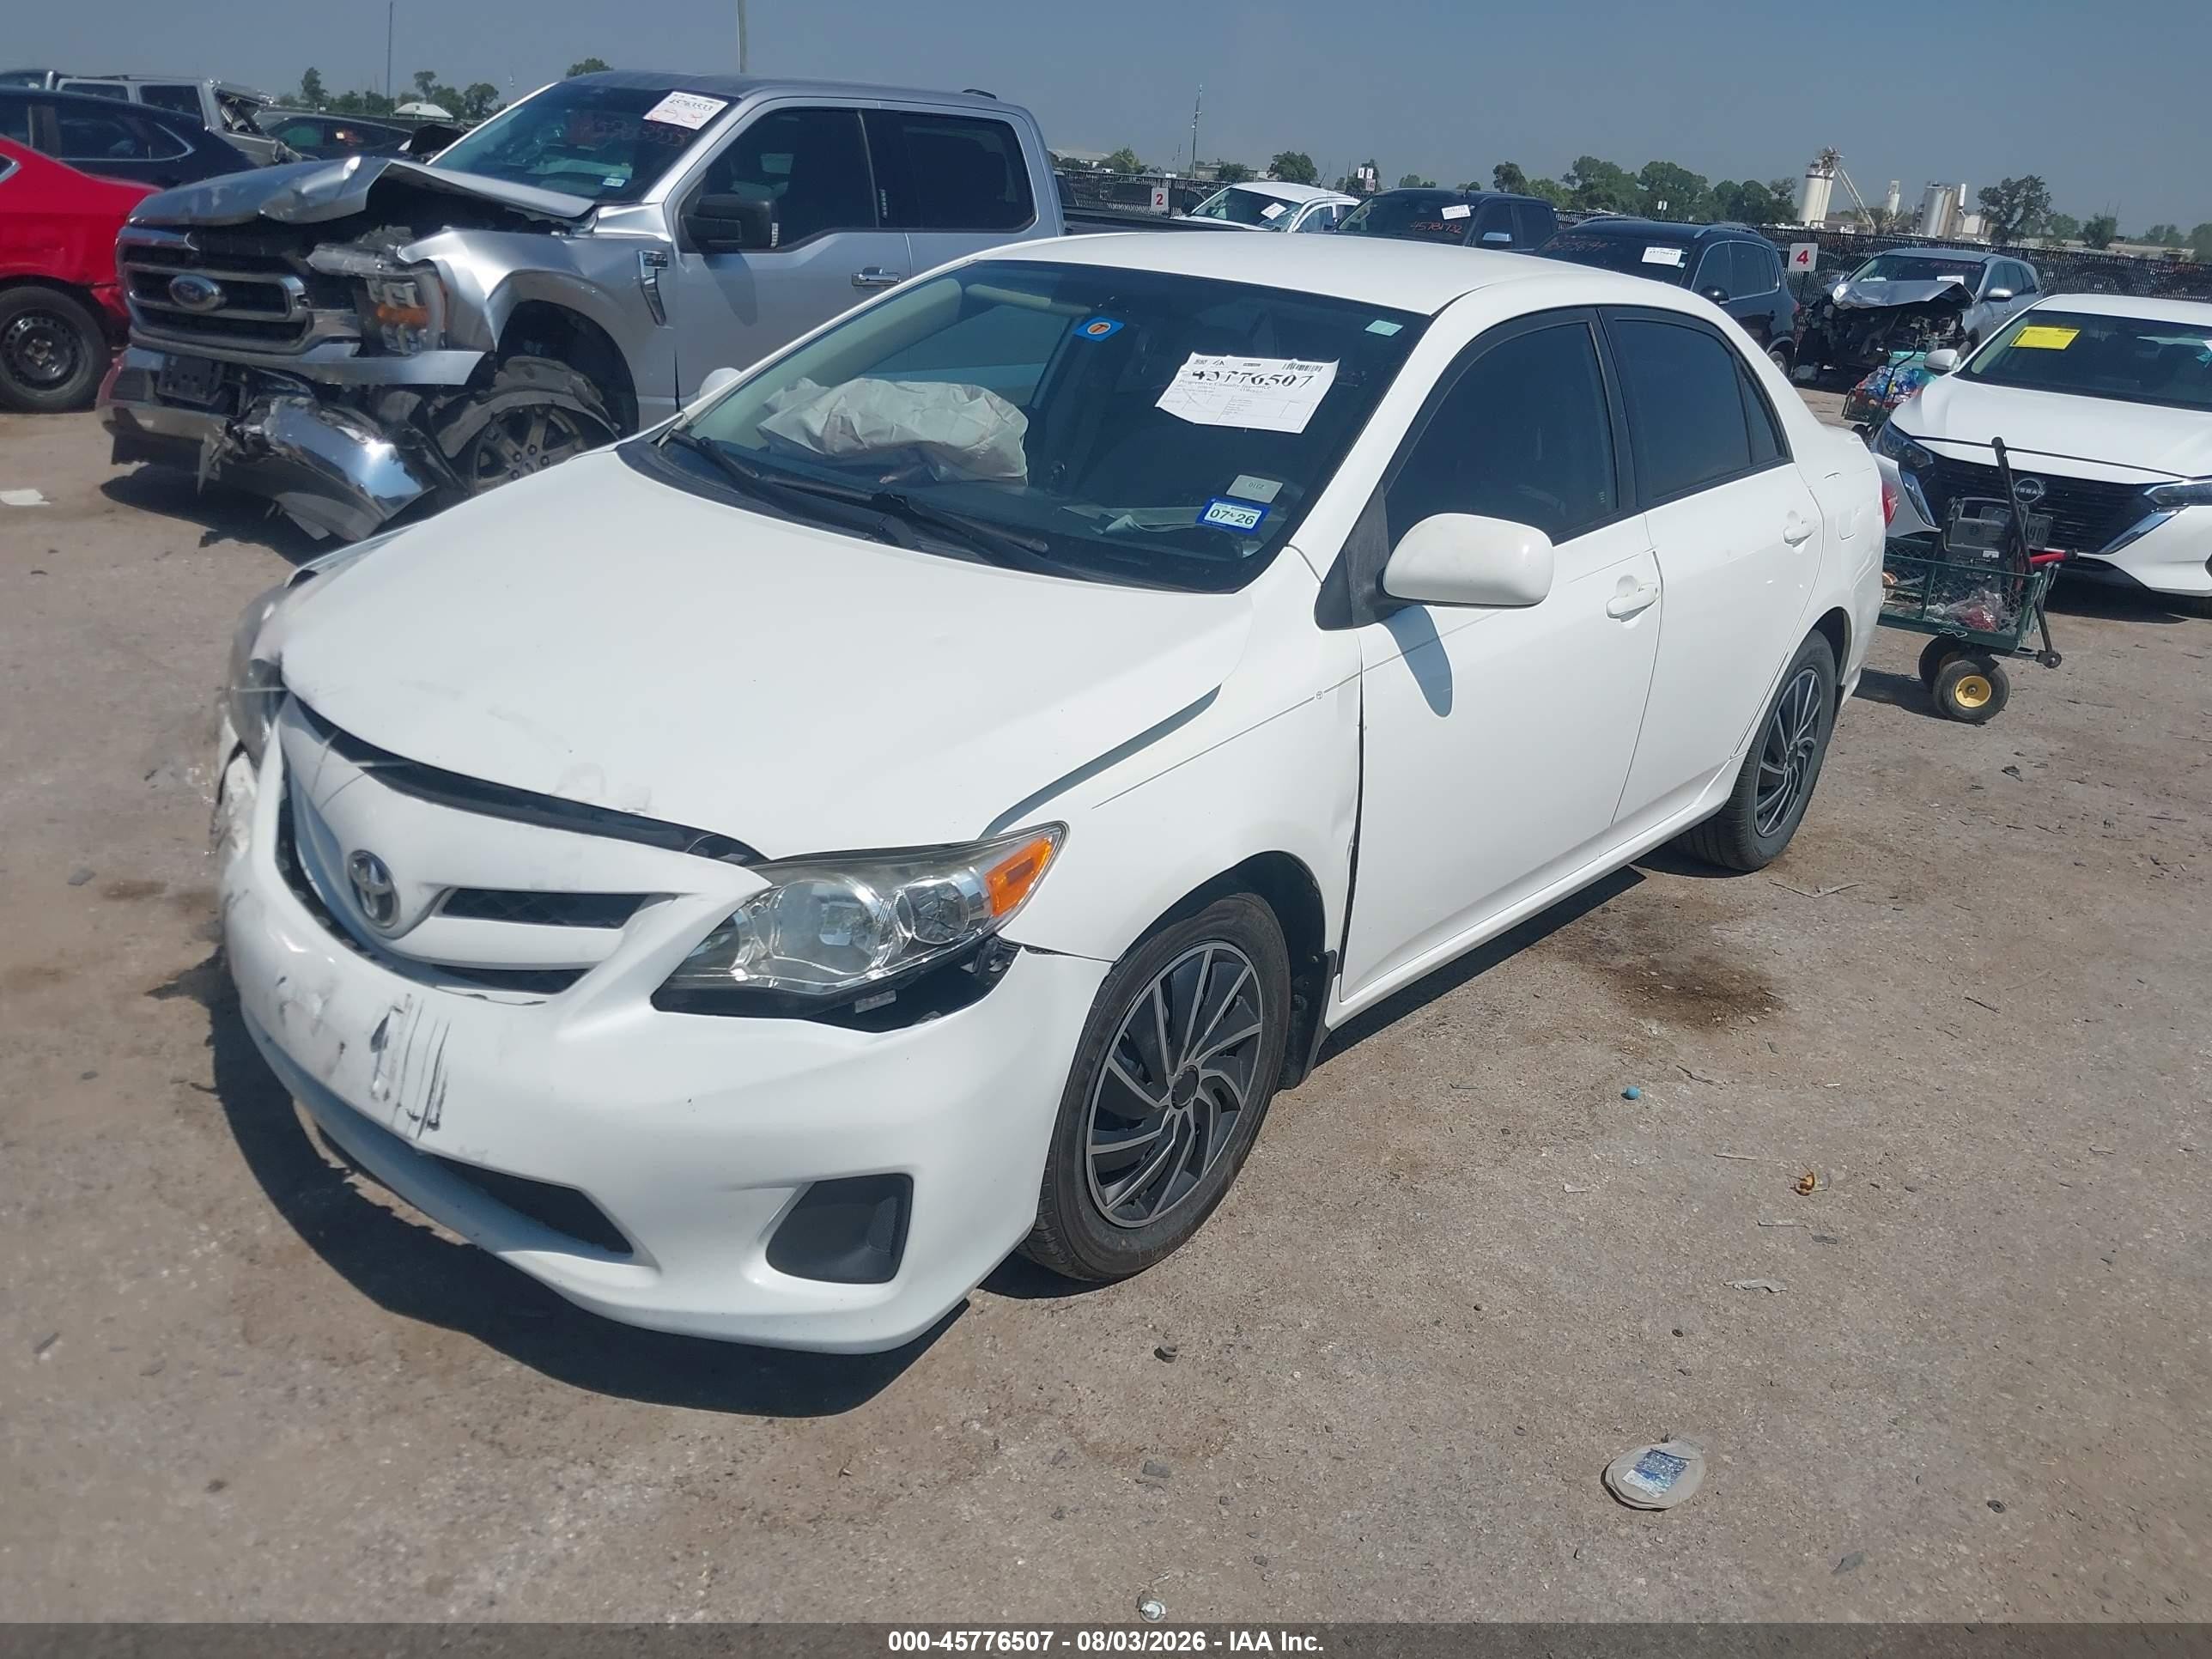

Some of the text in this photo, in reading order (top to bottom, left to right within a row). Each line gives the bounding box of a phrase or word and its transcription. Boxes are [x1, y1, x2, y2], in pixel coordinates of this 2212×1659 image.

[1156, 193, 1164, 205] 2
[1796, 250, 1809, 264] 4
[1192, 371, 1315, 389] 45776507
[1210, 508, 1231, 520] 07
[1235, 514, 1255, 525] 26
